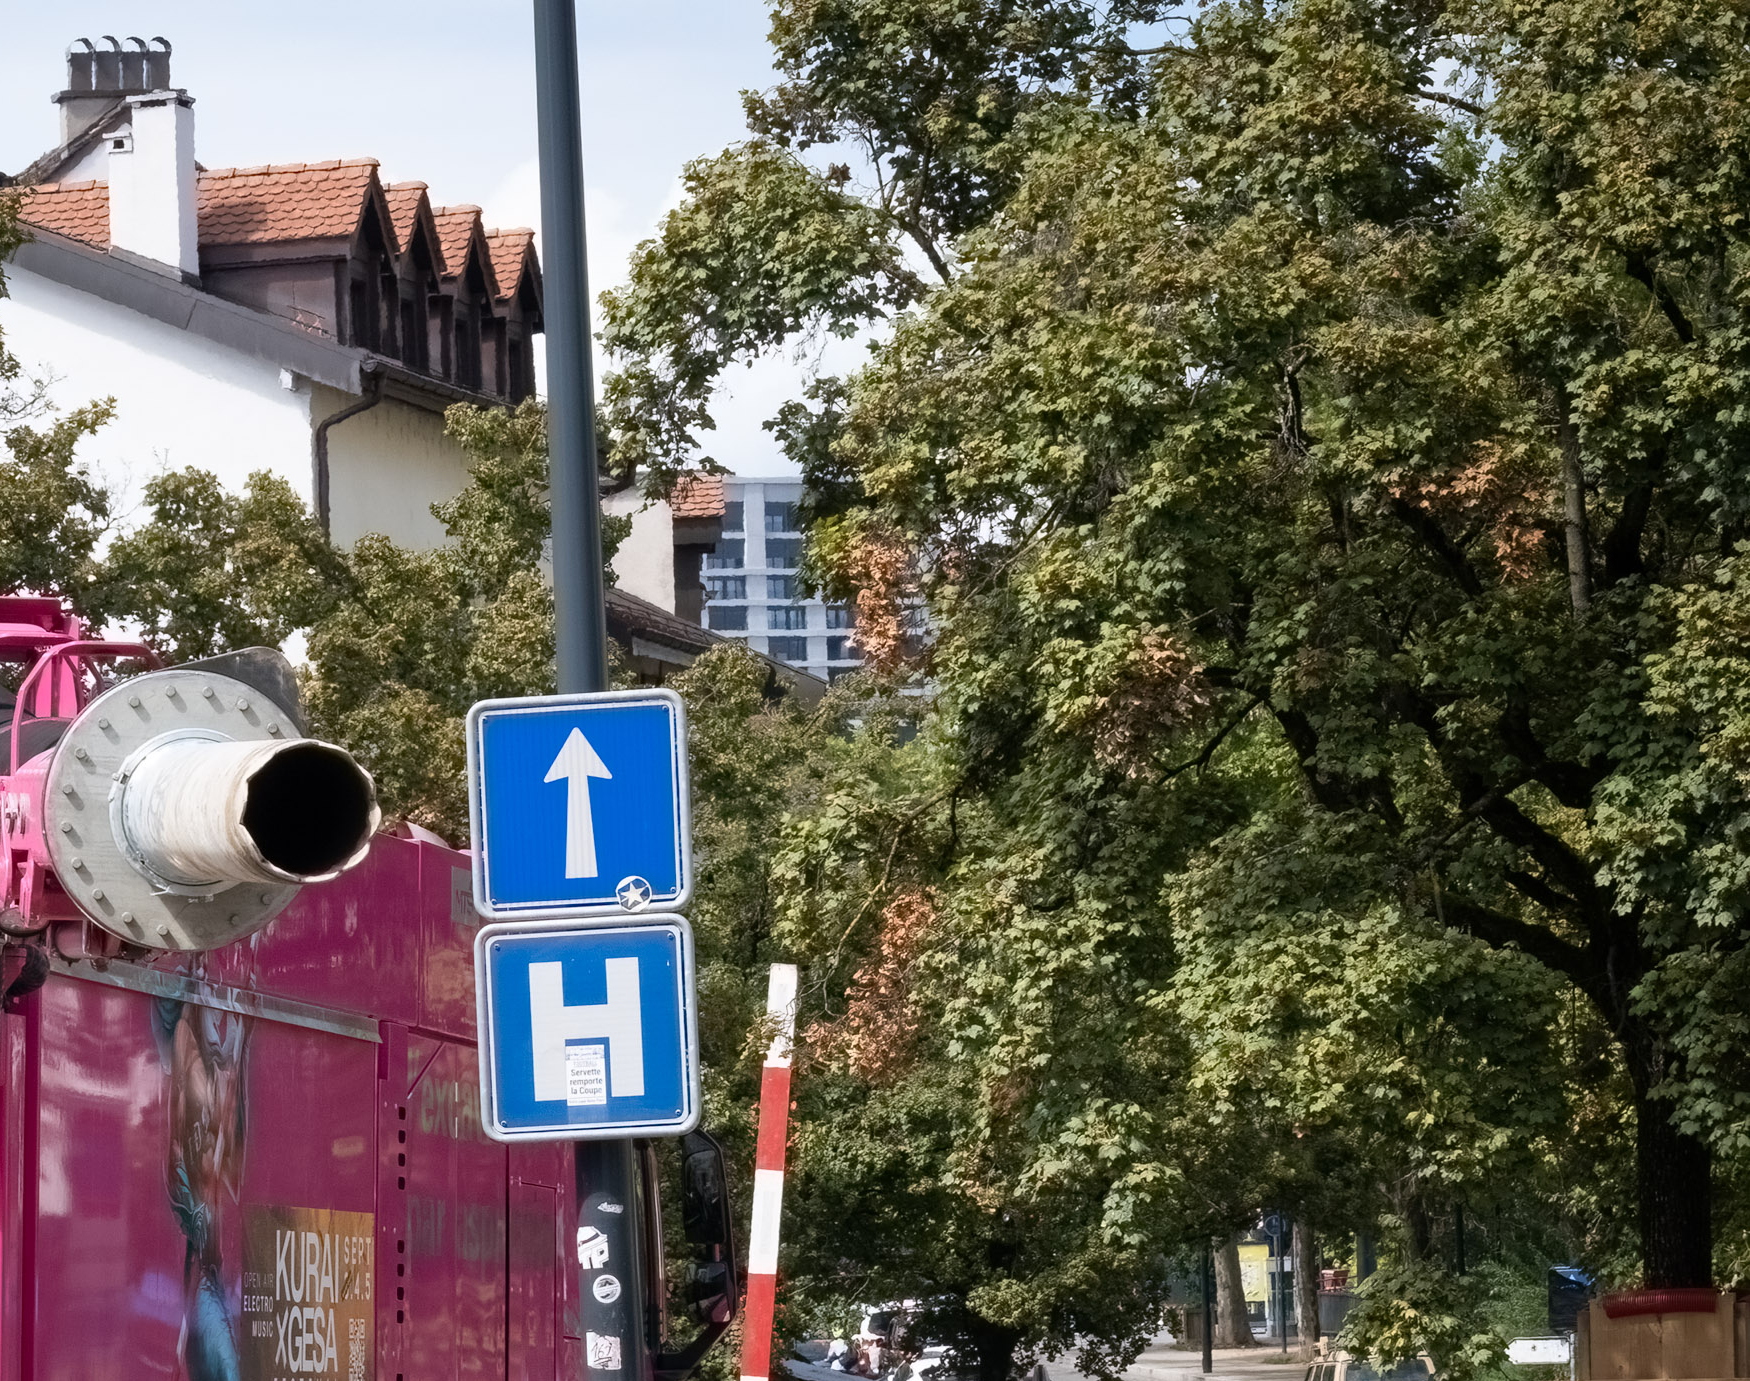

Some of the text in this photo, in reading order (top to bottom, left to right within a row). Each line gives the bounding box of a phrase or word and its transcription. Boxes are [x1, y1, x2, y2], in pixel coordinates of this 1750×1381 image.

[528, 956, 645, 1102] H
[570, 1068, 601, 1077] Servette
[569, 1077, 603, 1087] remporte
[570, 1086, 603, 1096] la Coupe
[344, 1235, 372, 1266] SEPT
[275, 1230, 340, 1304] KURAI
[243, 1271, 275, 1289] OPEN AIR
[243, 1295, 274, 1313] ELECTRO
[252, 1320, 274, 1338] MUSIC
[275, 1305, 339, 1373] XGESA
